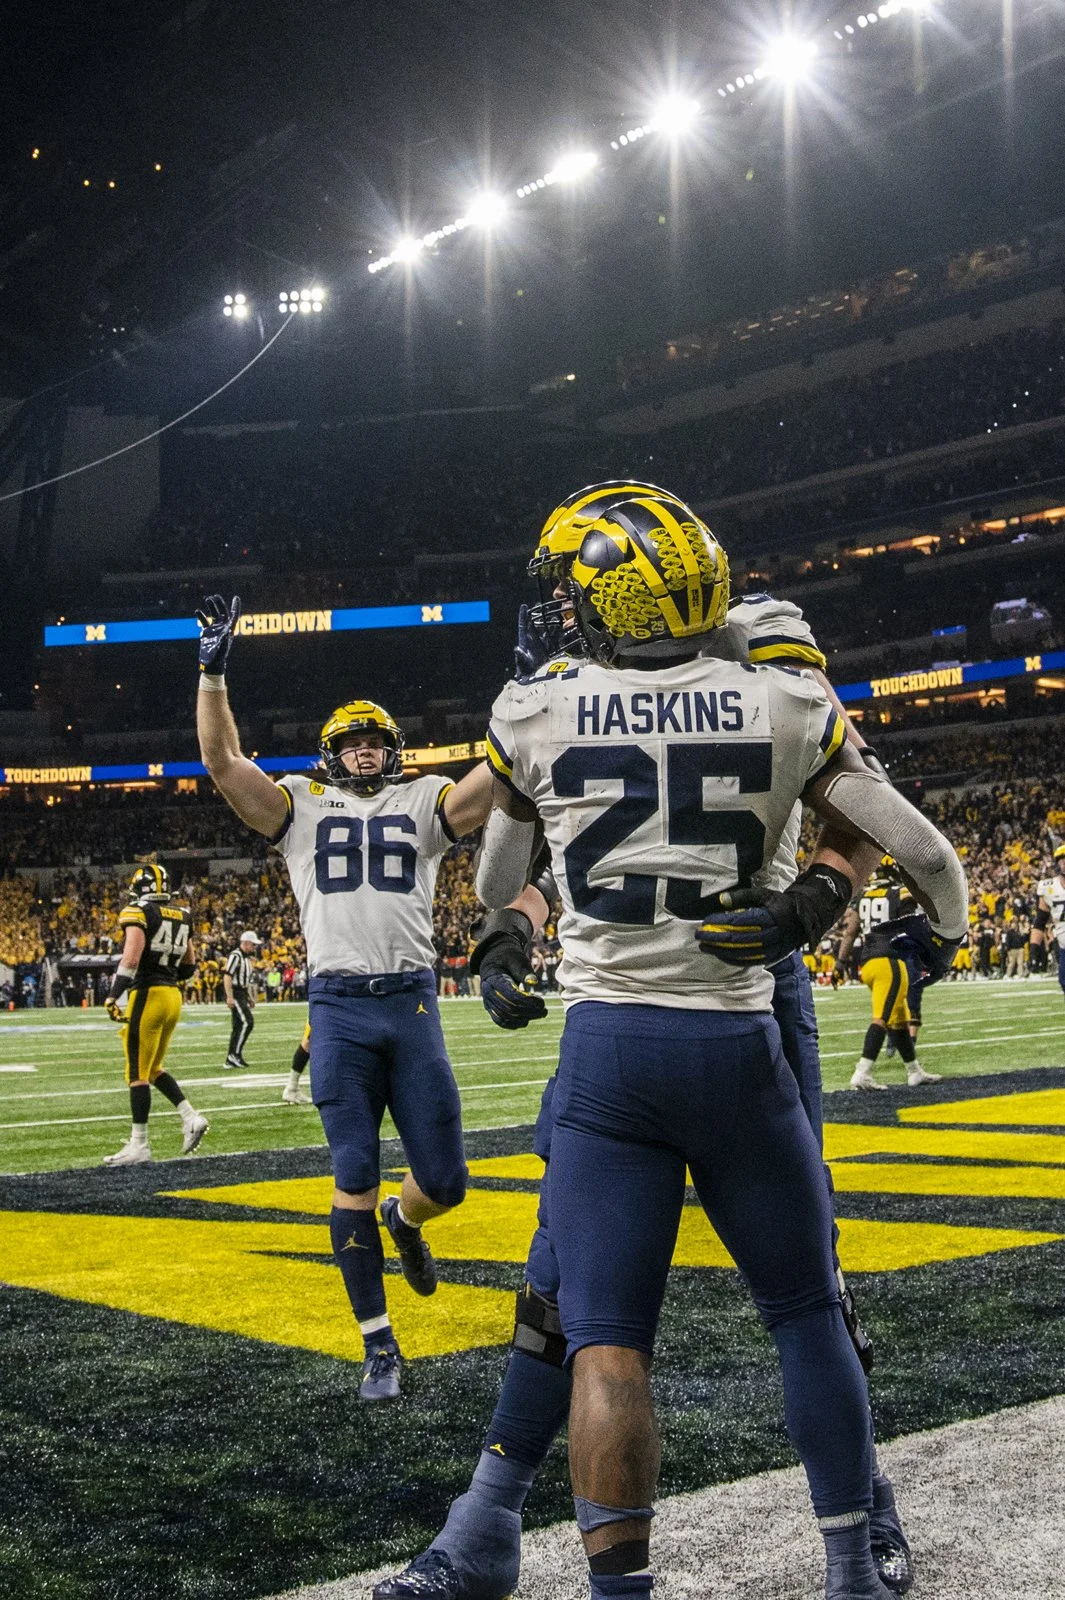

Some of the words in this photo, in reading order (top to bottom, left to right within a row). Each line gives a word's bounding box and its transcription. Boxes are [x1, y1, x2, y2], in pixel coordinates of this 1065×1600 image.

[197, 610, 332, 636] CHDOWN
[421, 605, 443, 622] M
[85, 624, 106, 641] M
[1025, 656, 1042, 671] M
[871, 667, 963, 697] TOUCHDOWN
[577, 691, 744, 735] HASKINS
[4, 766, 92, 783] TOUCHDOWN
[148, 764, 163, 776] M
[551, 741, 773, 925] 25
[314, 814, 418, 895] 86
[859, 897, 890, 934] 99
[150, 920, 190, 968] 44
